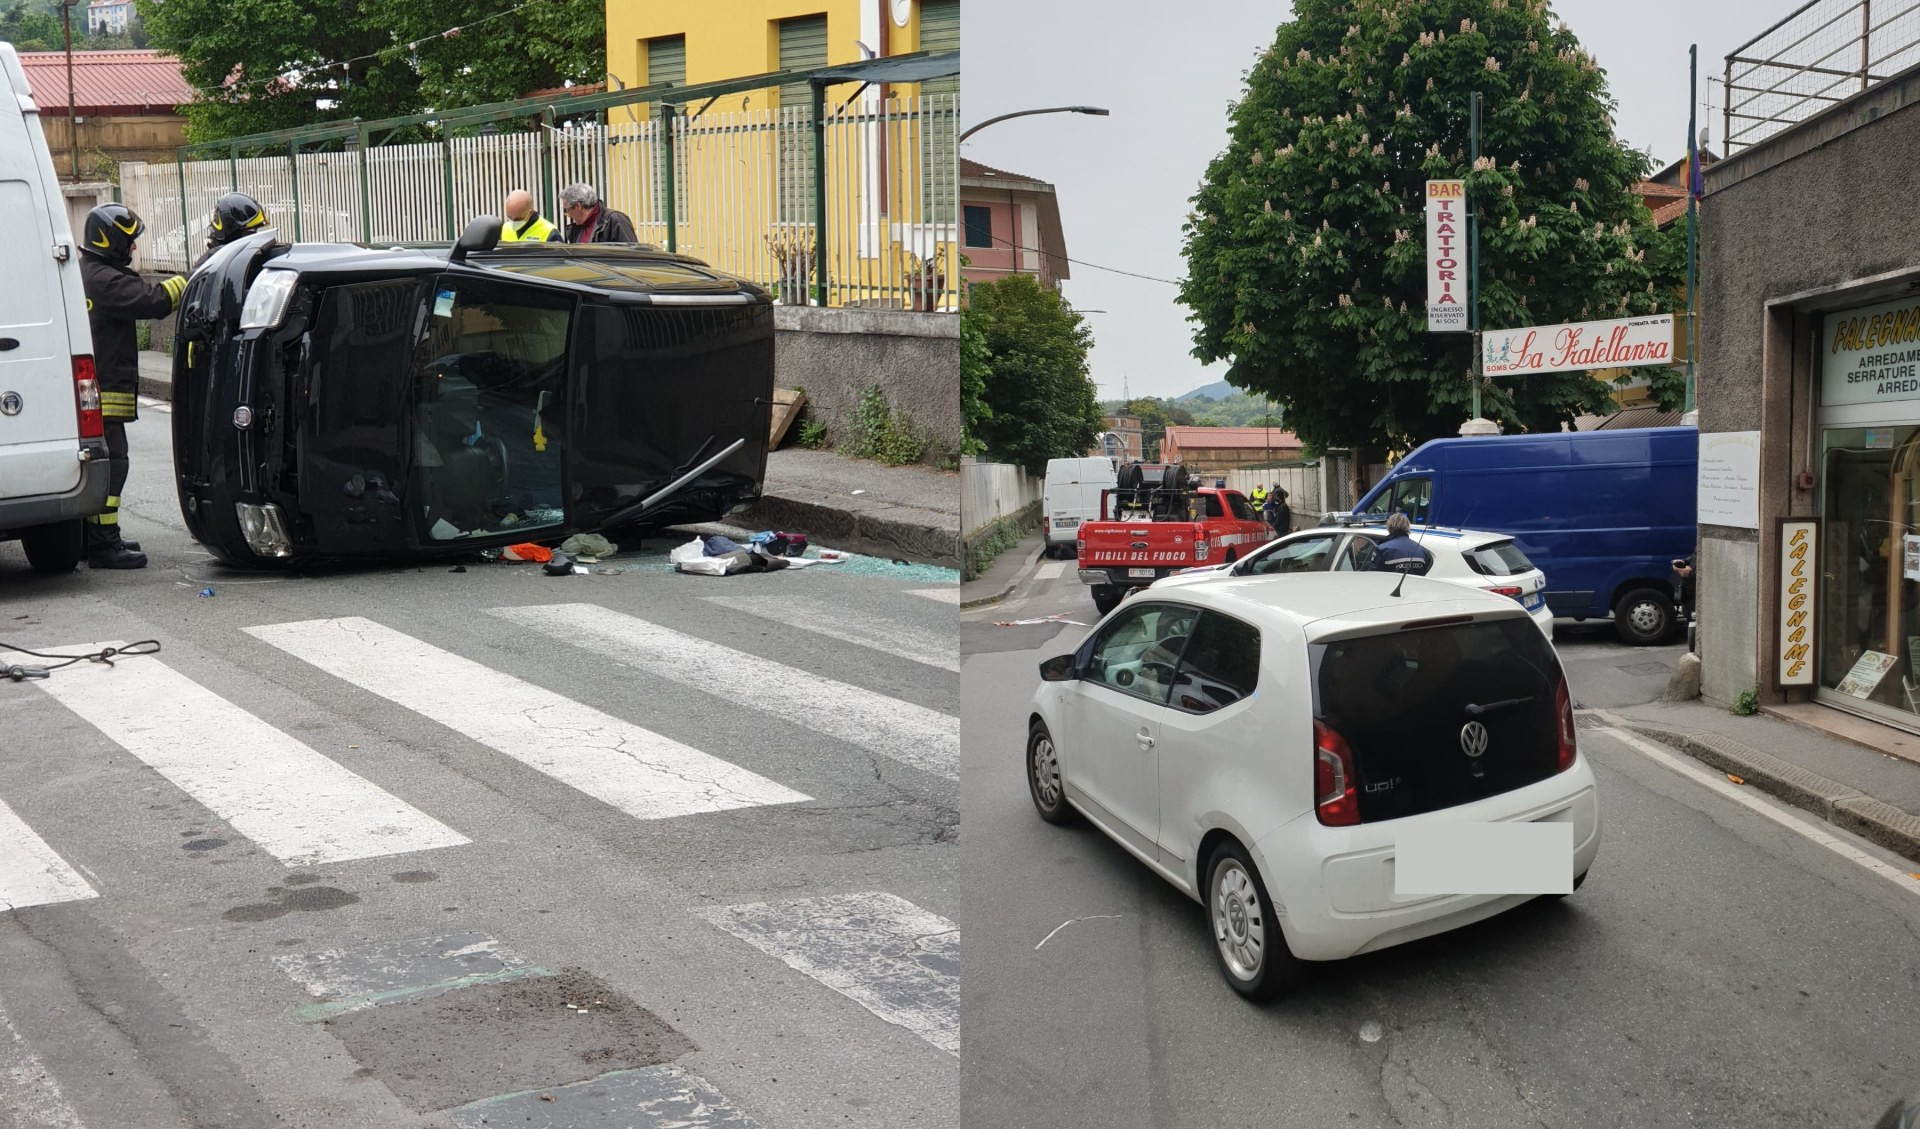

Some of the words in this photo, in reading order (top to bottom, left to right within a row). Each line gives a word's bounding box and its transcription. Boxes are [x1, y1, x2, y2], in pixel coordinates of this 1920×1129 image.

[1429, 184, 1462, 196] BAR
[1436, 200, 1457, 304] TRATTORIA
[1832, 305, 1920, 354] FALEGNA
[1509, 330, 1544, 370] La
[1550, 325, 1668, 367] Fratellanza
[1847, 364, 1916, 384] SERRATURE
[1877, 379, 1920, 394] ARRED
[1094, 551, 1126, 560] VIGILI
[1131, 551, 1149, 560] DEL
[1153, 551, 1186, 560] FUOCO
[1784, 529, 1809, 677] FALEGNAME
